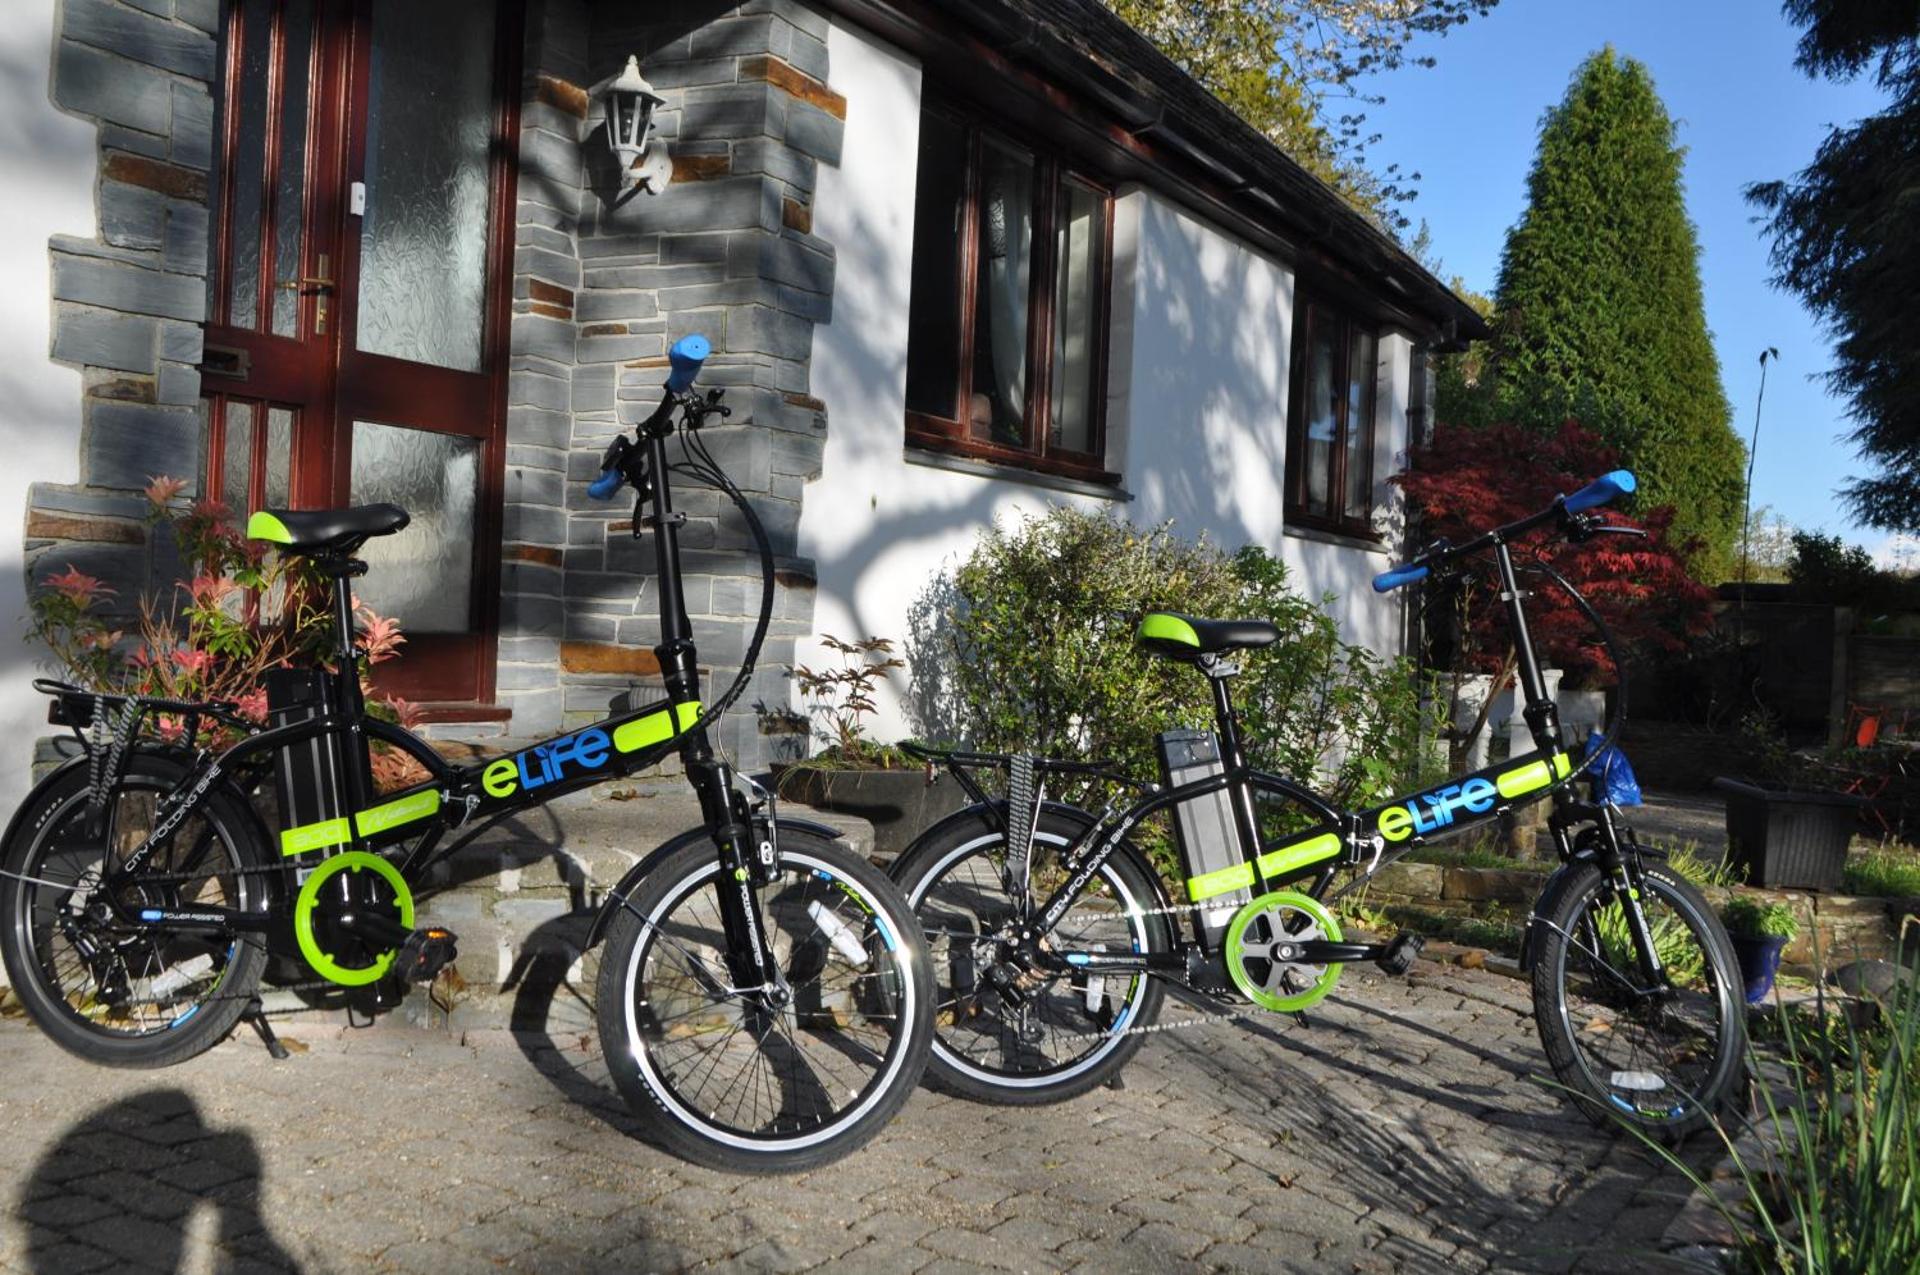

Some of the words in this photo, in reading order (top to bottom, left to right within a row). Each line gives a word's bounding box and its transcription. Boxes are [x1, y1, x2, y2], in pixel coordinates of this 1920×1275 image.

[124, 844, 149, 872] CITY
[149, 794, 198, 846] FOLDING
[196, 765, 222, 793] BIKE
[1068, 843, 1113, 895] FOLDING
[1110, 815, 1135, 843] BIKE
